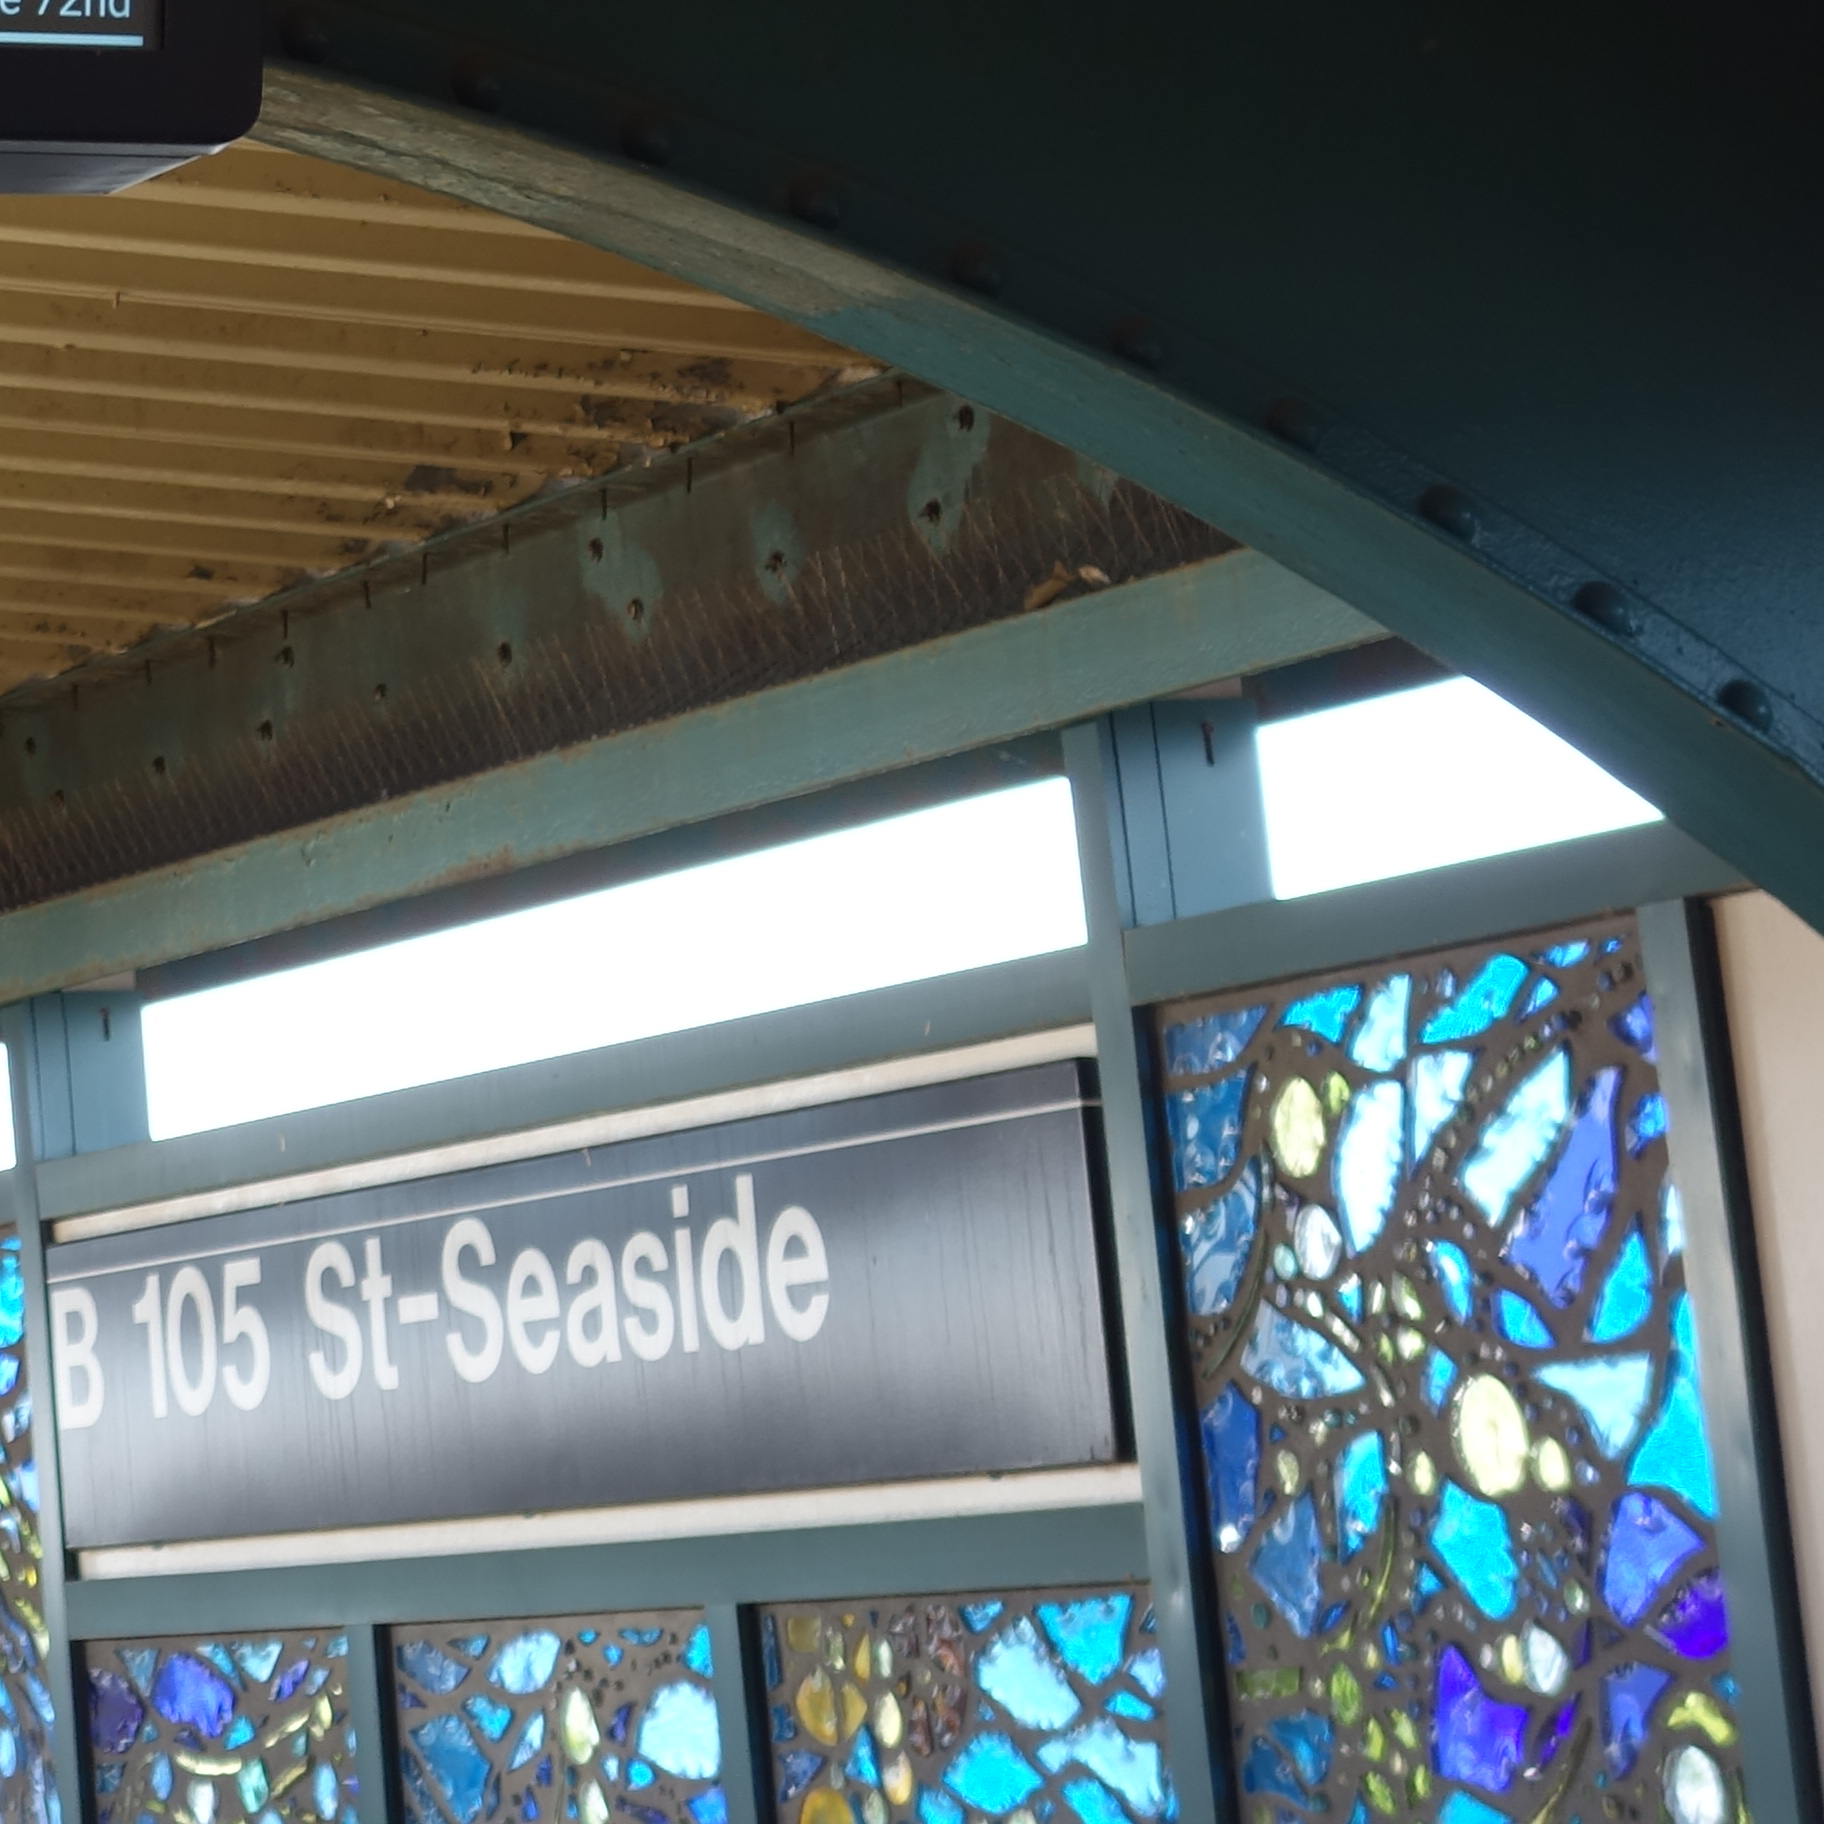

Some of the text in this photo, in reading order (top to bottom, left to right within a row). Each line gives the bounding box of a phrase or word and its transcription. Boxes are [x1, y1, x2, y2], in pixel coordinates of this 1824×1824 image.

[51, 1173, 830, 1431] B 105 St-Seaside
